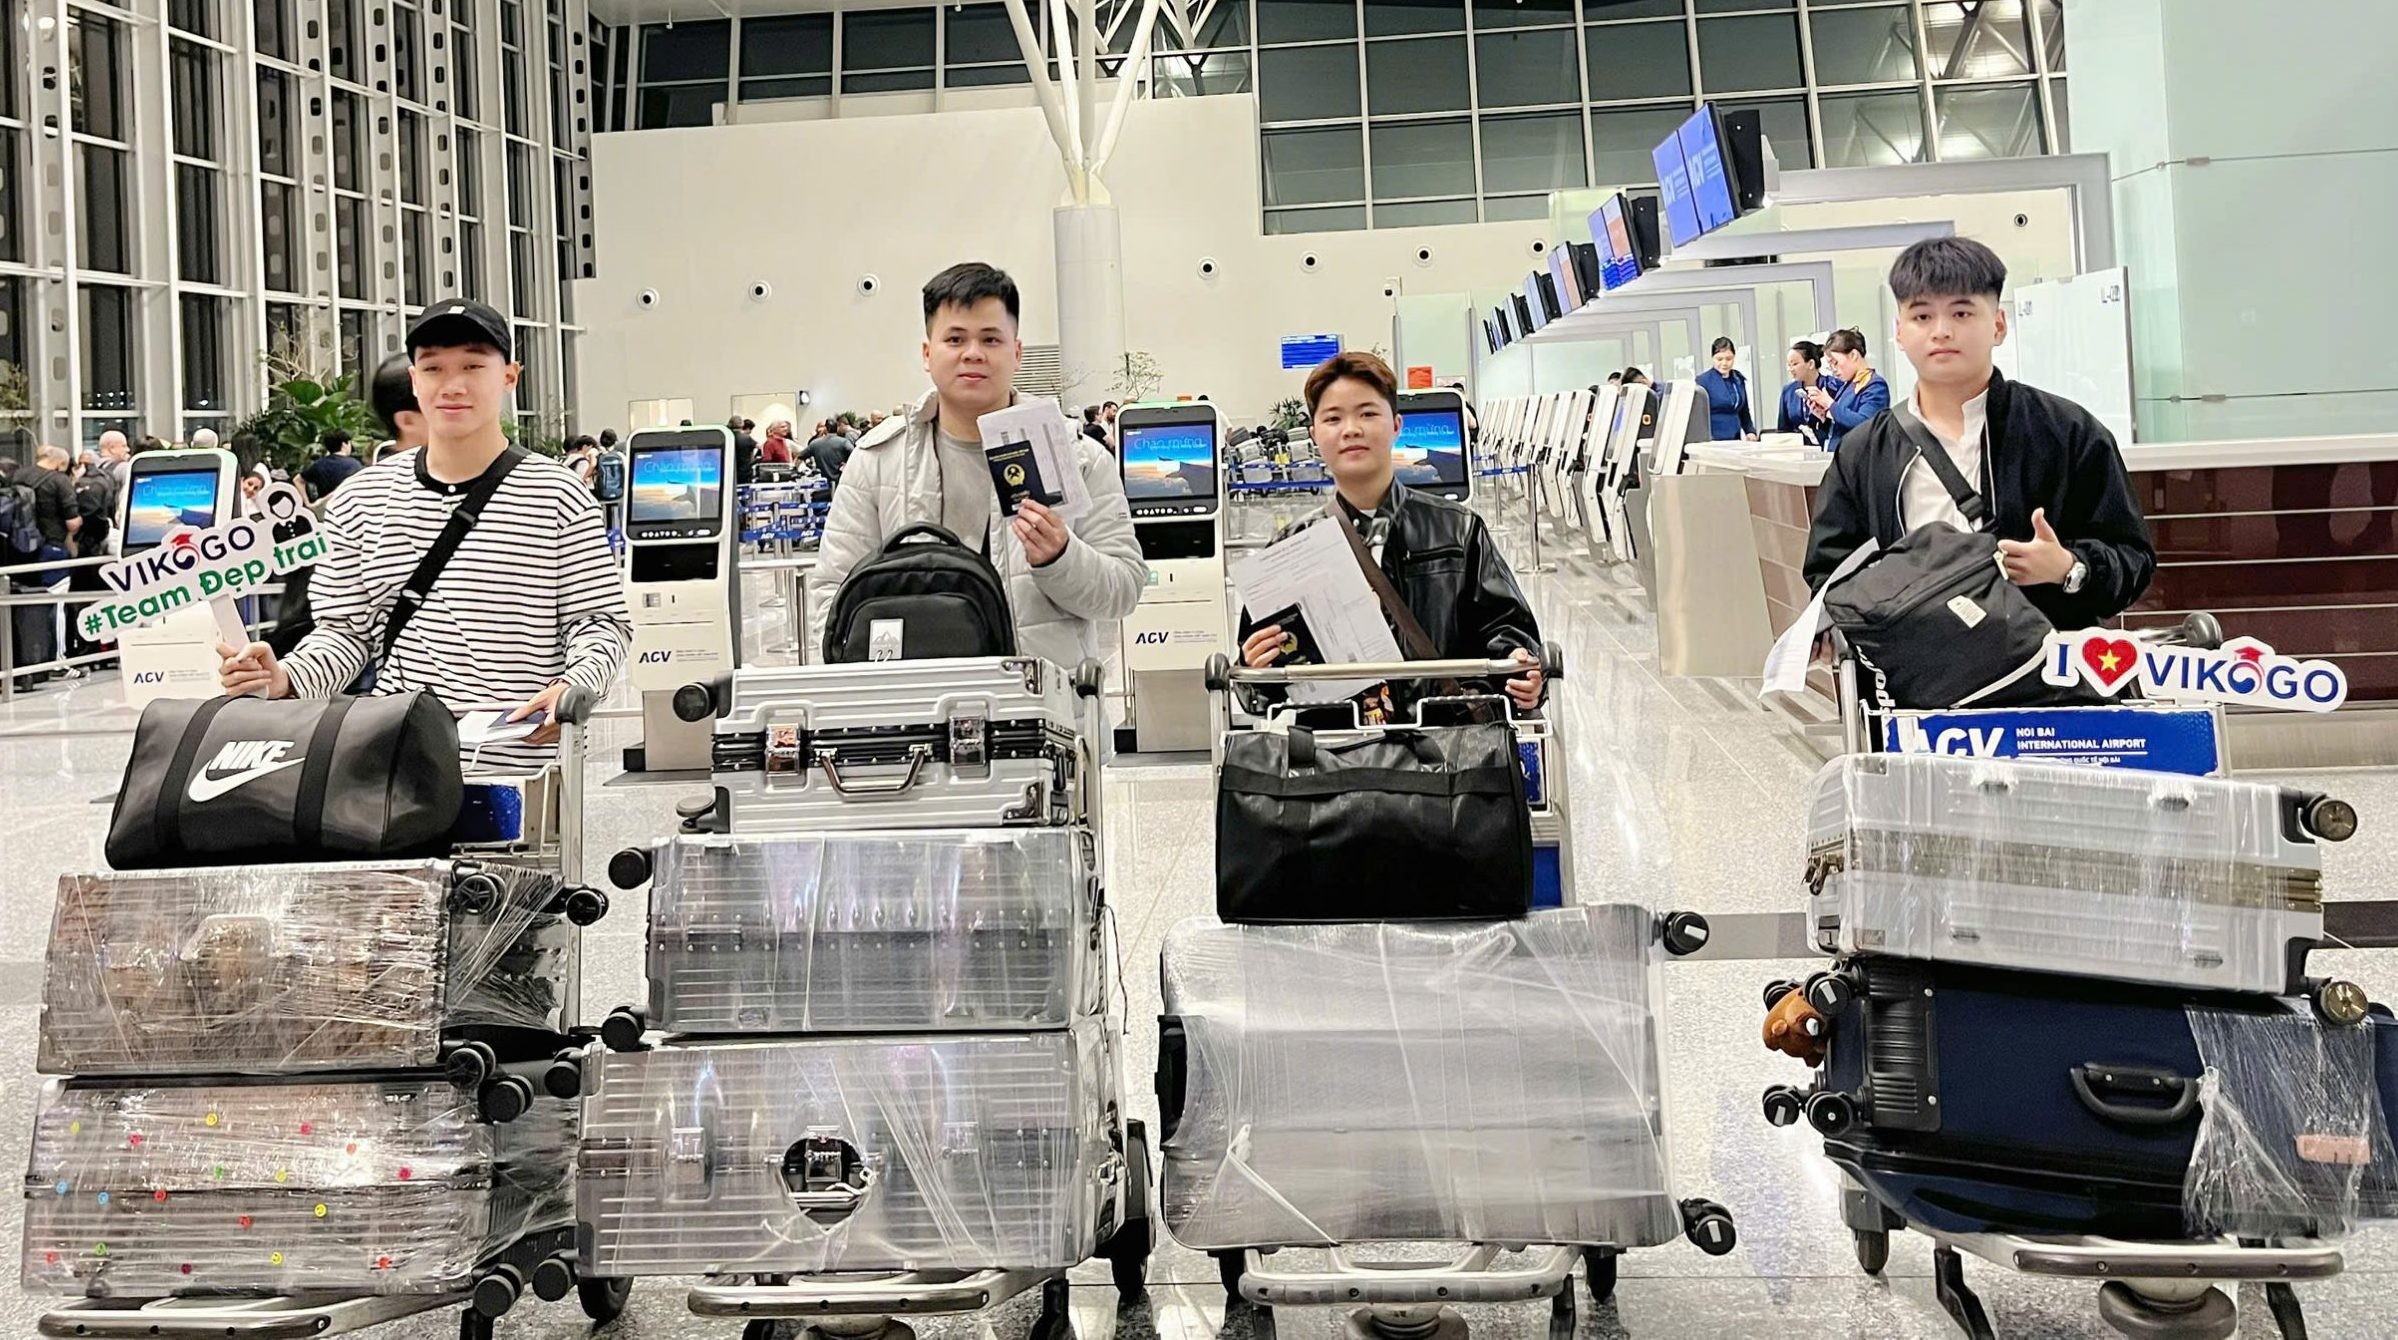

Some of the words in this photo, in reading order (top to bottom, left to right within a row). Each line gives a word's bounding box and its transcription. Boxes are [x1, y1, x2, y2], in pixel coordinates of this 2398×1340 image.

[108, 525, 256, 592] VIKOGO
[84, 585, 192, 635] #Team
[199, 559, 266, 594] Đẹp
[273, 531, 328, 569] trai
[1135, 631, 1169, 645] ACV
[638, 650, 672, 664] ACV
[133, 671, 165, 684] ACV
[2057, 643, 2070, 677] I
[2145, 651, 2339, 704] VIKOGO
[2016, 727, 2035, 737] NOI
[2037, 727, 2056, 737] BAI
[2017, 739, 2100, 750] INTERNATIONAL
[2102, 738, 2147, 749] AIRPORT
[207, 740, 296, 770] NIKE
